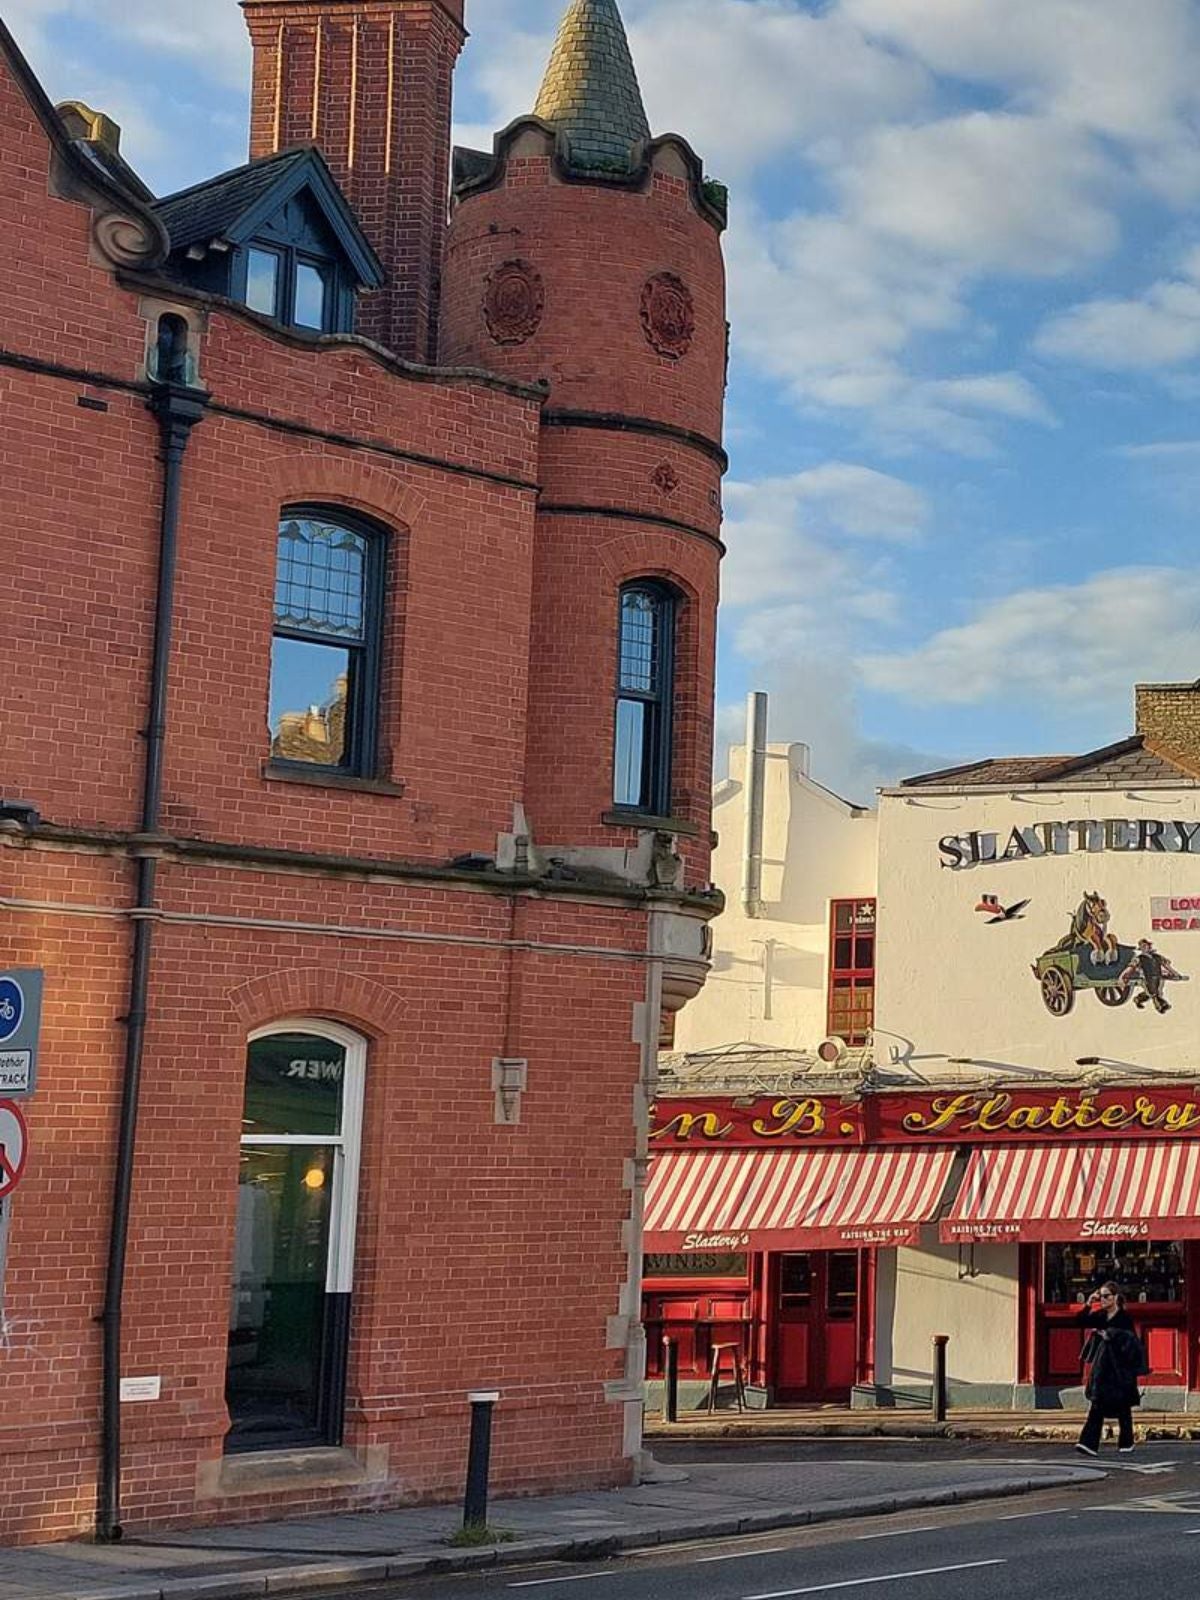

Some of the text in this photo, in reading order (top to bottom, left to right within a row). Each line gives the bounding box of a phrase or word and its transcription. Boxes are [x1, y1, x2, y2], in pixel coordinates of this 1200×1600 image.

[1152, 918, 1186, 930] FOR
[752, 1098, 854, 1137] B.
[1080, 1220, 1149, 1238] Slattery's
[682, 1232, 749, 1250] Slattery's
